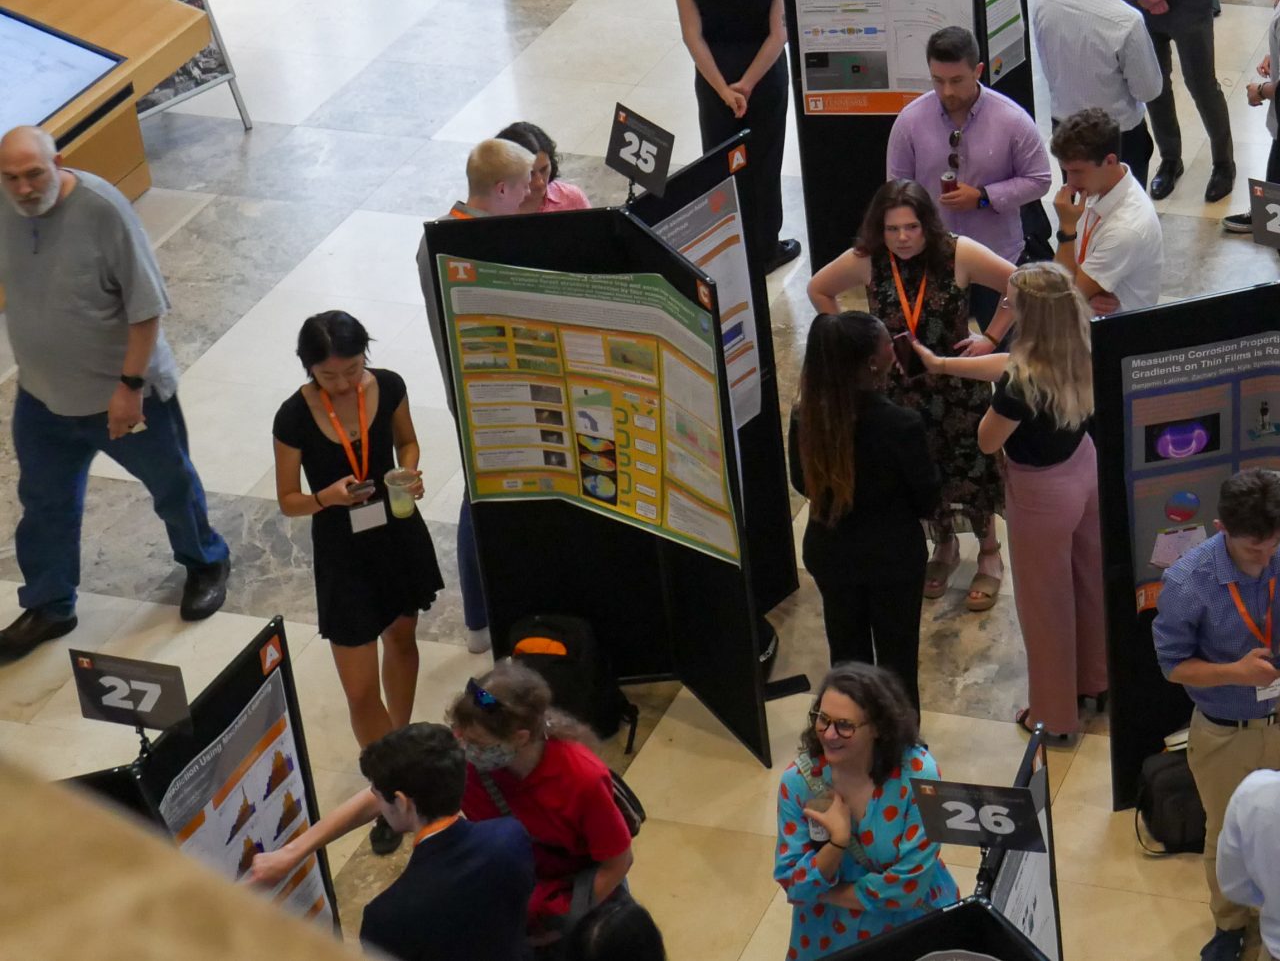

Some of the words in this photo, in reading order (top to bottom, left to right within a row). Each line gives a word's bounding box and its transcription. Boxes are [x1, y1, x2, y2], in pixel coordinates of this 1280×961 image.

[619, 131, 658, 174] 25
[732, 151, 746, 169] A
[449, 261, 472, 279] T
[1131, 353, 1185, 368] Measuring
[1188, 343, 1237, 359] Corrosion
[1131, 365, 1181, 379] Gradients
[1184, 362, 1198, 371] on
[1201, 358, 1222, 368] Thin
[1224, 351, 1252, 363] Films
[1254, 349, 1263, 357] is
[264, 644, 280, 670] A
[98, 676, 162, 713] 27
[200, 742, 223, 767] Using
[941, 801, 1016, 835] 26
